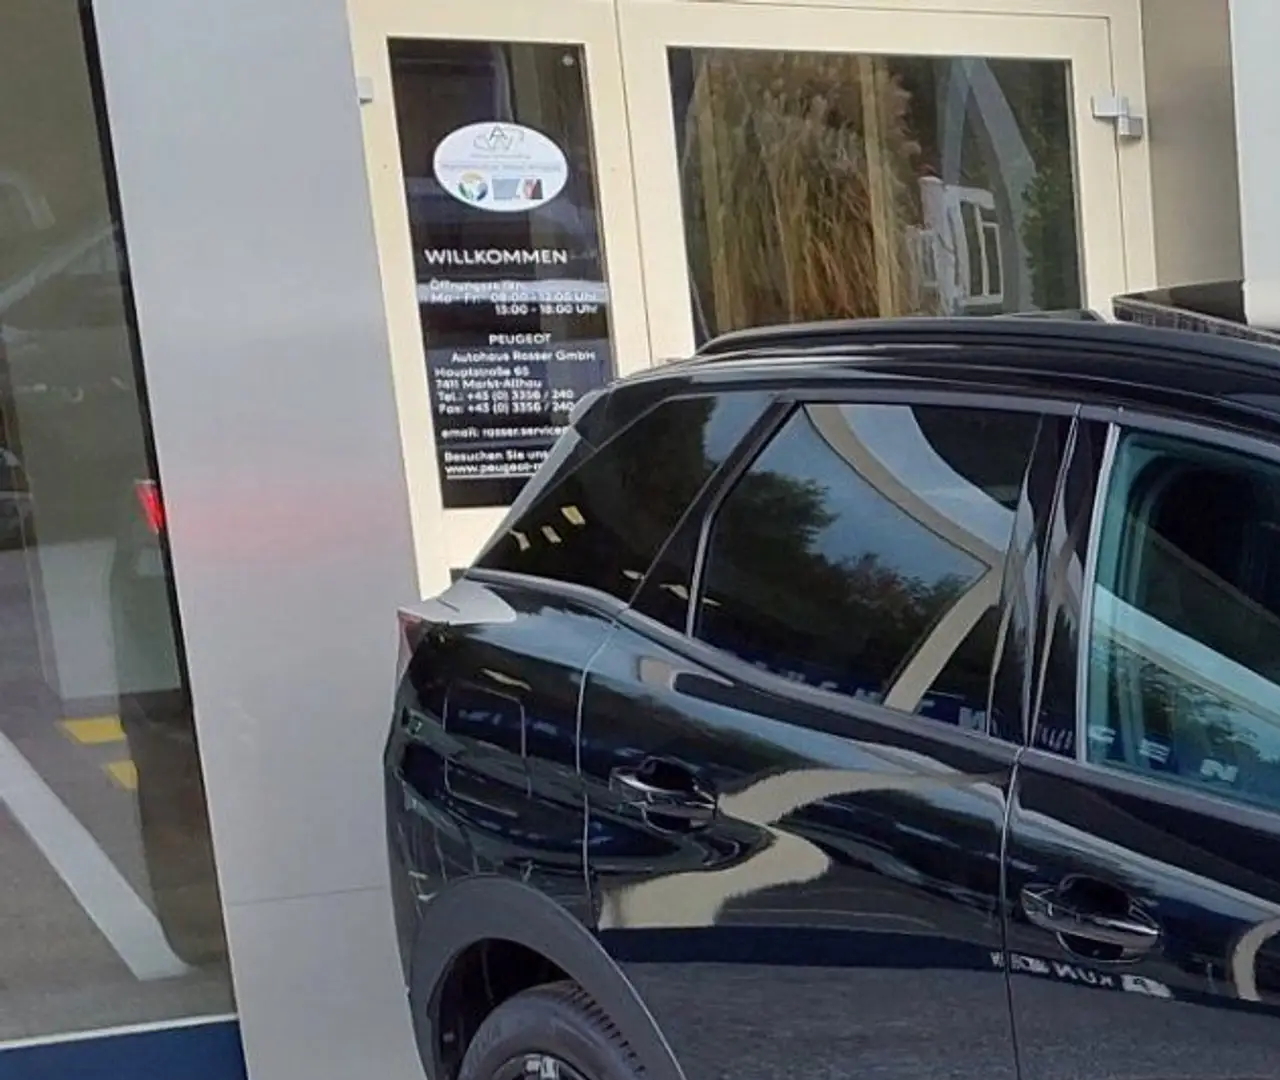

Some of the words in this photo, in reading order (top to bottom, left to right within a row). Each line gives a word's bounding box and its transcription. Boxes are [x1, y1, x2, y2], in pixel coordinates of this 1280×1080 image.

[424, 250, 569, 265] WILLKOMMEN
[576, 302, 598, 314] Uhr
[488, 333, 552, 345] PEUGEOT
[452, 351, 510, 363] Autohaus
[555, 349, 596, 361] GmbH
[434, 366, 511, 379] Hauptstraße
[462, 378, 542, 389] Markt-Allhau
[467, 390, 490, 401] +43
[491, 388, 510, 403] (0)
[467, 402, 490, 413] +43
[491, 400, 510, 415] (0)
[444, 451, 504, 463] Besuchen
[506, 449, 525, 461] Sie
